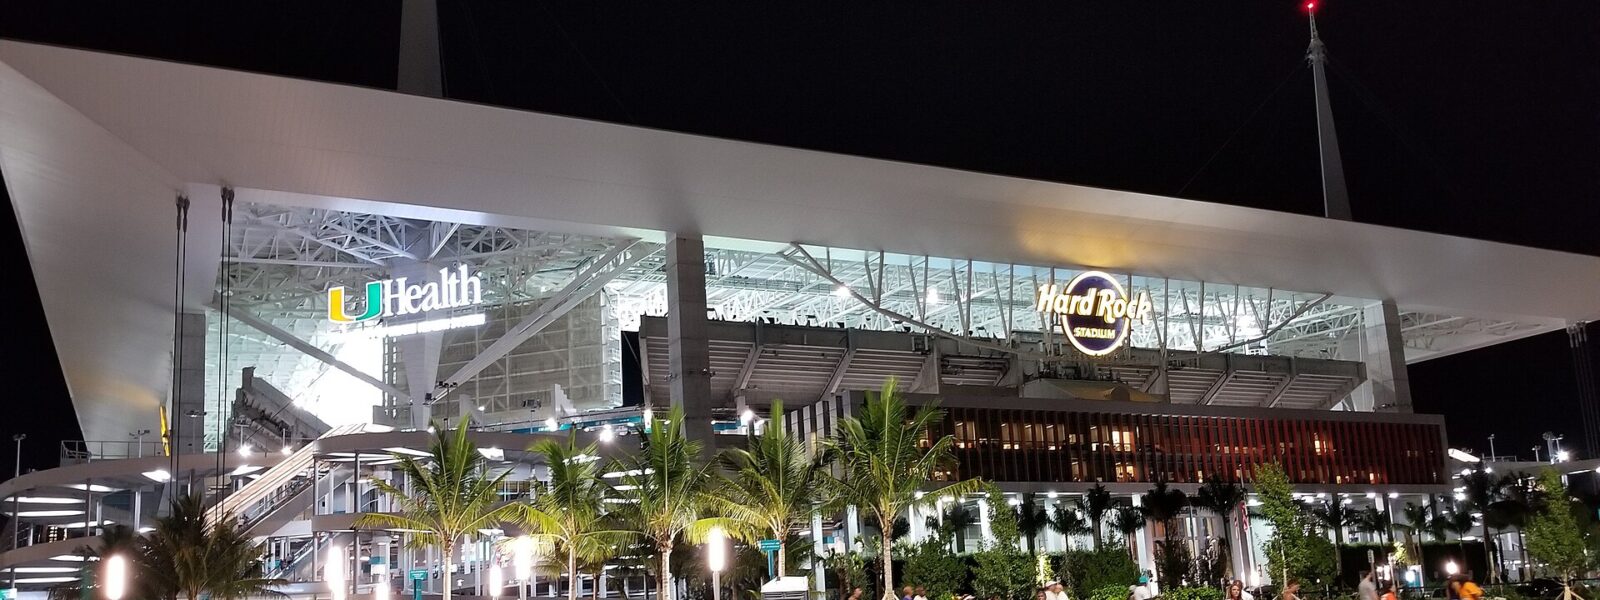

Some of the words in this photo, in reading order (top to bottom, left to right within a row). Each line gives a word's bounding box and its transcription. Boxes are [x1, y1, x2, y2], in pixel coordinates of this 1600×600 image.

[1036, 283, 1097, 316] Hard
[1096, 288, 1152, 325] Rock
[1073, 327, 1116, 339] STADIUM
